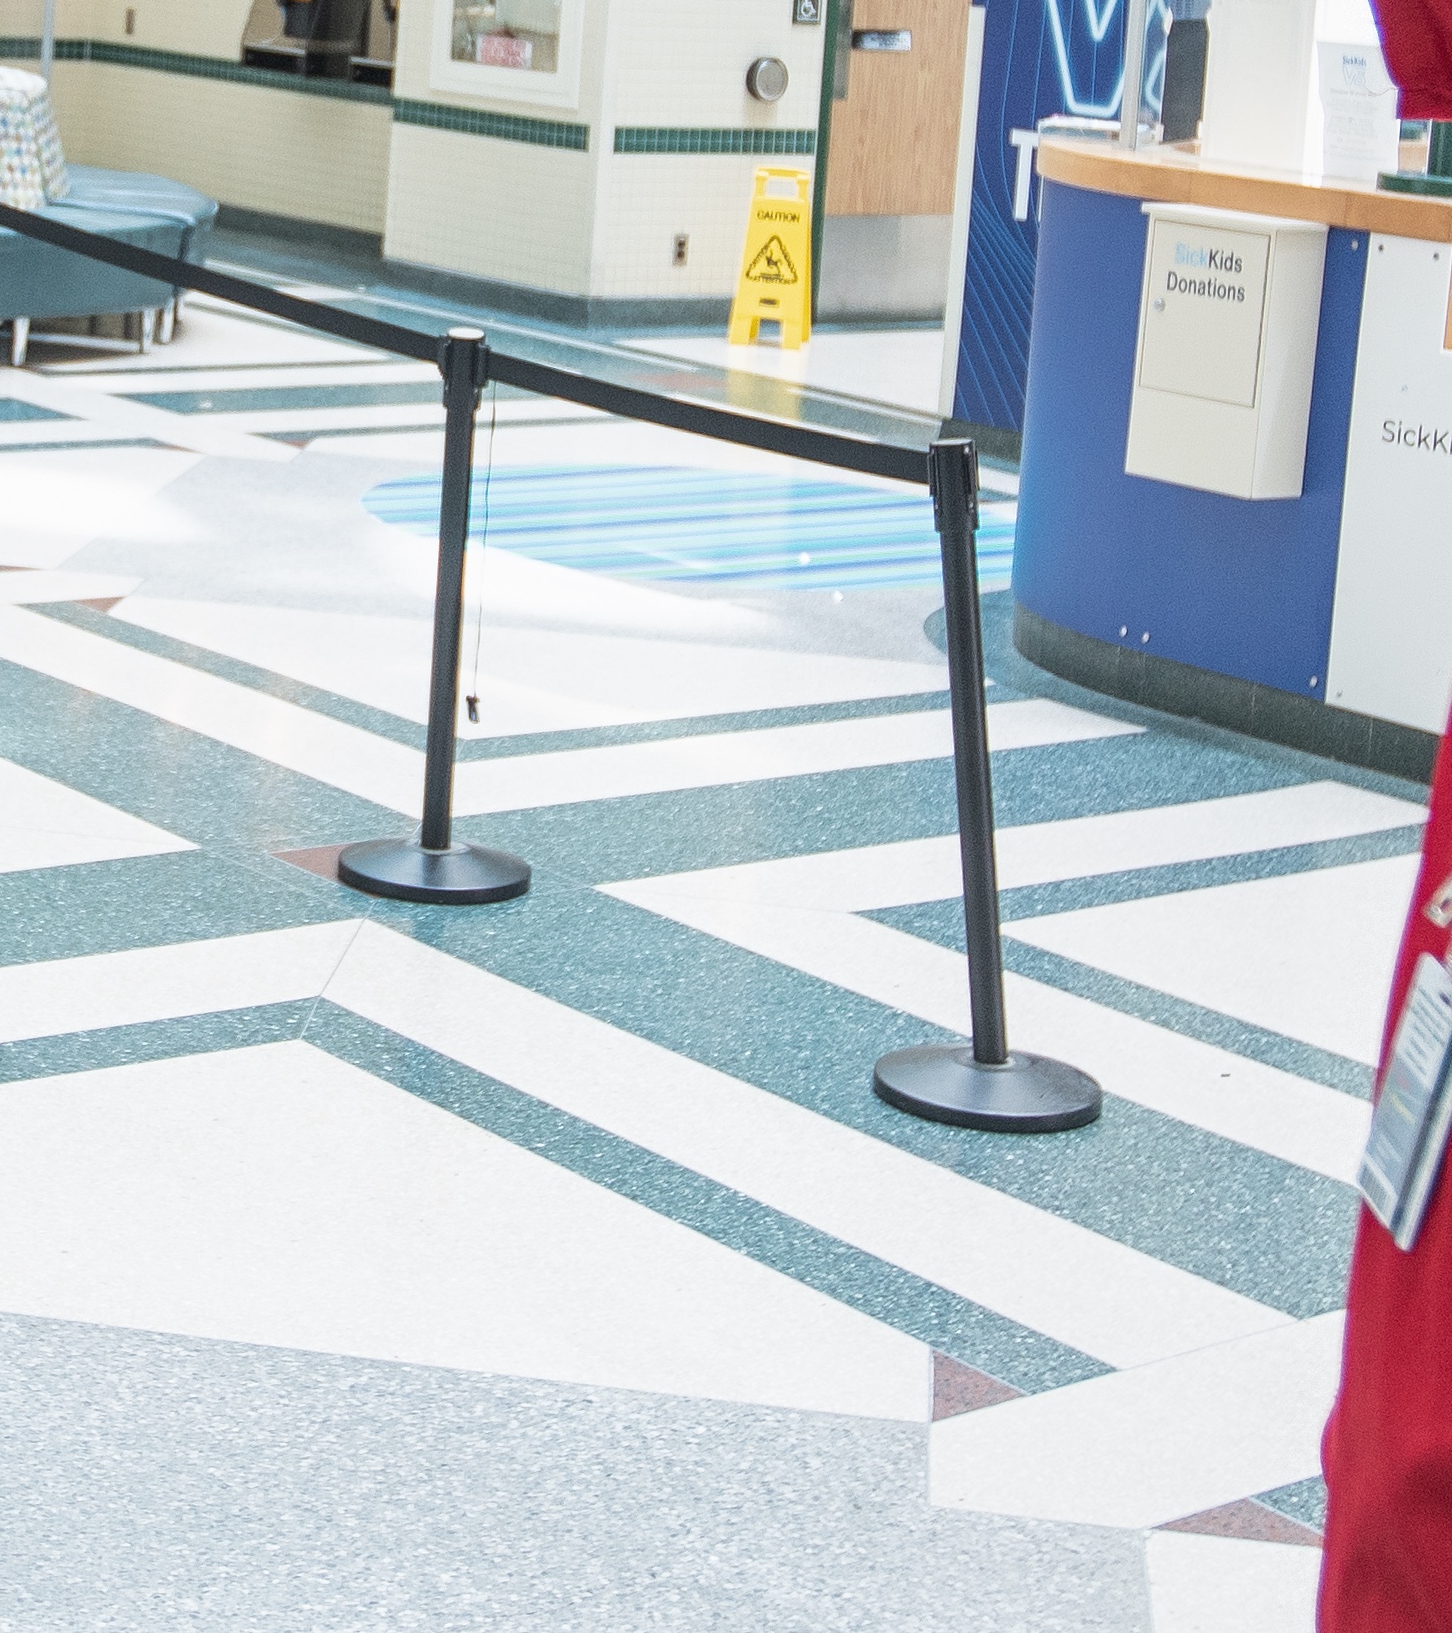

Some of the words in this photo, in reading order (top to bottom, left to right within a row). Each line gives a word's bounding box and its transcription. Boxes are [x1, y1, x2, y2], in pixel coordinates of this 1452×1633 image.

[757, 210, 800, 223] CAUTION
[1174, 241, 1243, 274] SickKids
[1166, 270, 1246, 303] Donations
